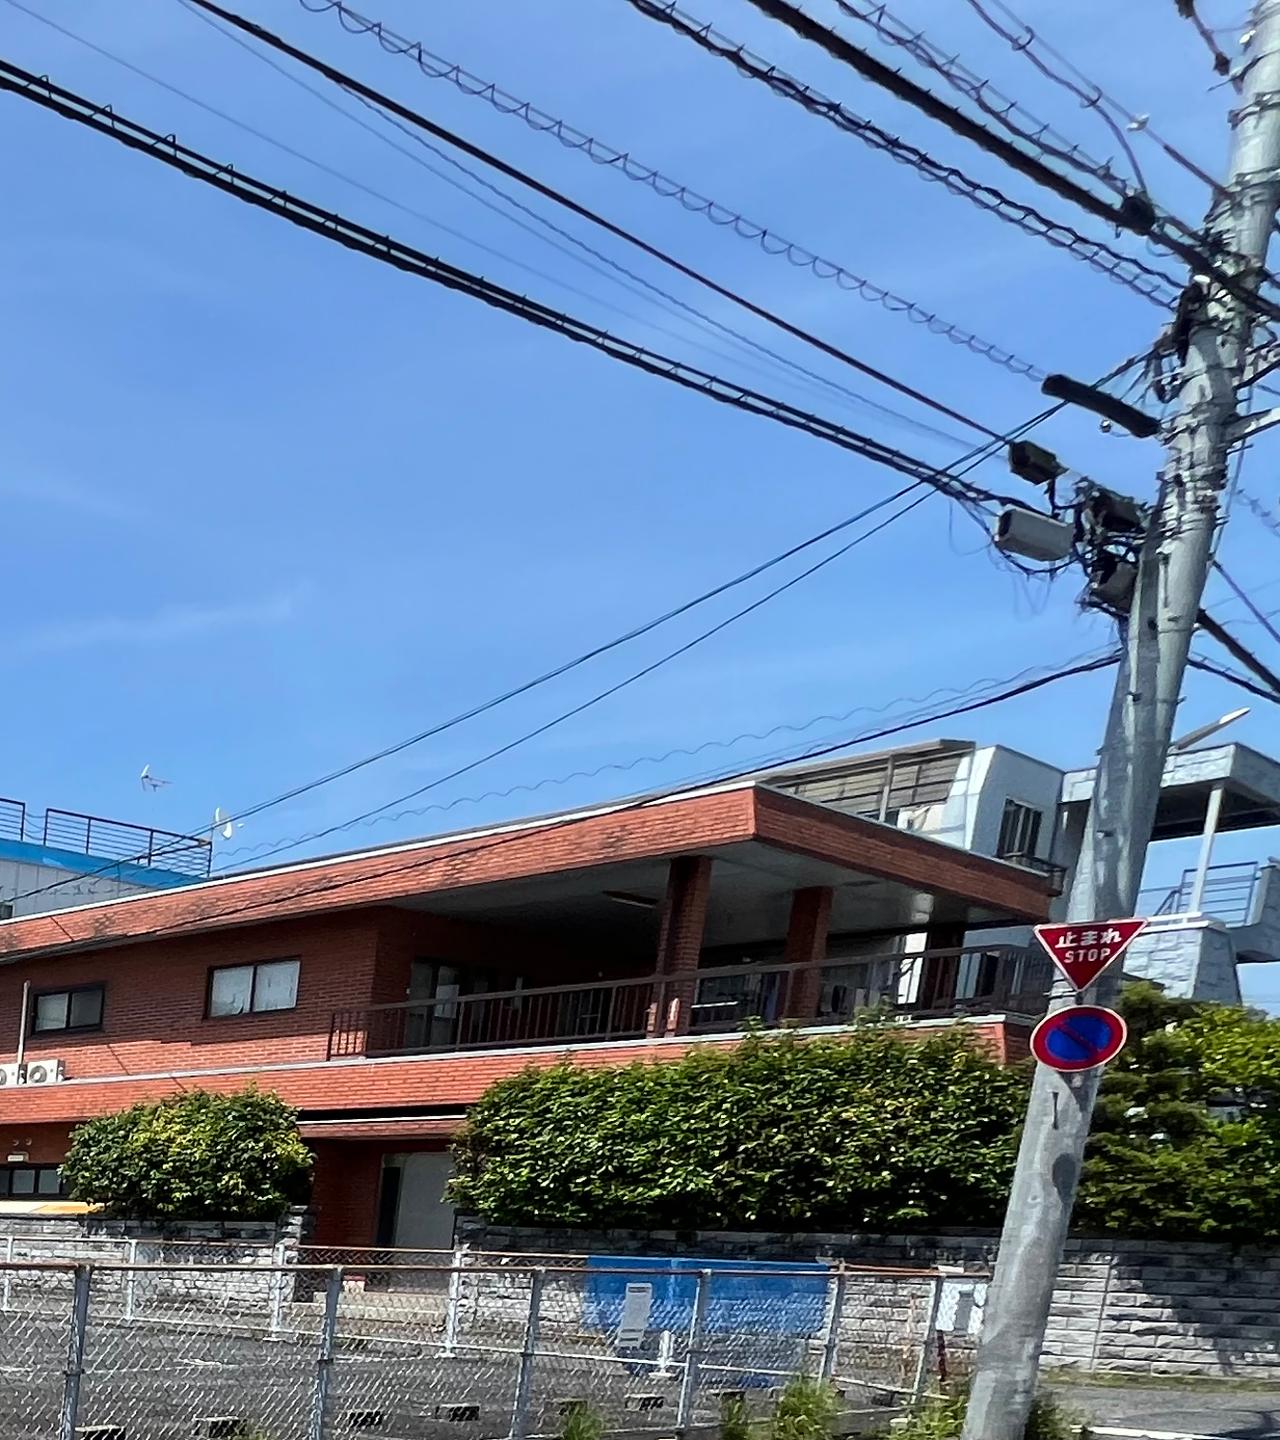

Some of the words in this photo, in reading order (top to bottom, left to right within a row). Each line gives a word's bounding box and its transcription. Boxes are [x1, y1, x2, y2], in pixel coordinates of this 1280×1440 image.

[1054, 927, 1122, 949] 止まれ
[1064, 948, 1111, 964] STOP
